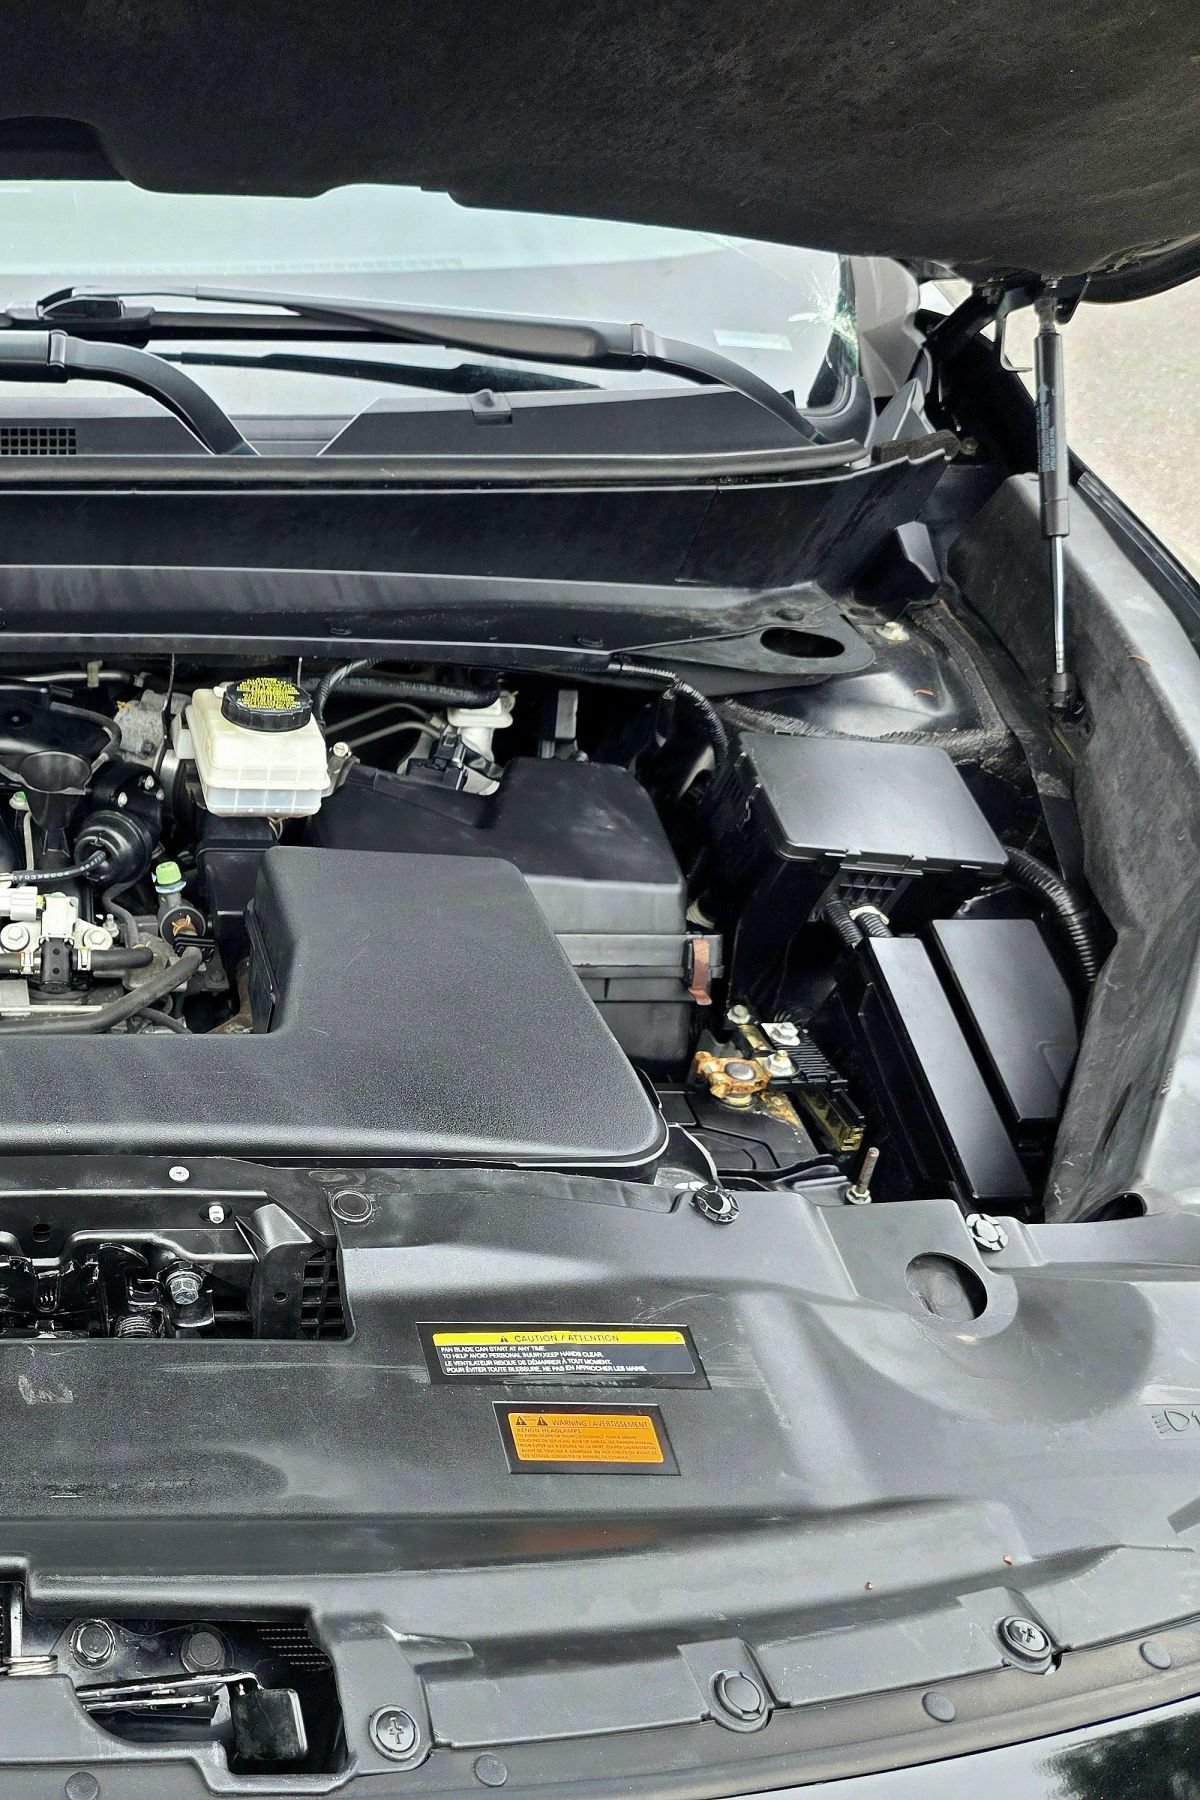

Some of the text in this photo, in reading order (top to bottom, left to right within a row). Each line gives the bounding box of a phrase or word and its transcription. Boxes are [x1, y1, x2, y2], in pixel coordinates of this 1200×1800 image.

[514, 1334, 558, 1343] CAUTION
[568, 1334, 619, 1342] ATTENTION
[592, 1420, 648, 1428] AVERTISSEMENT
